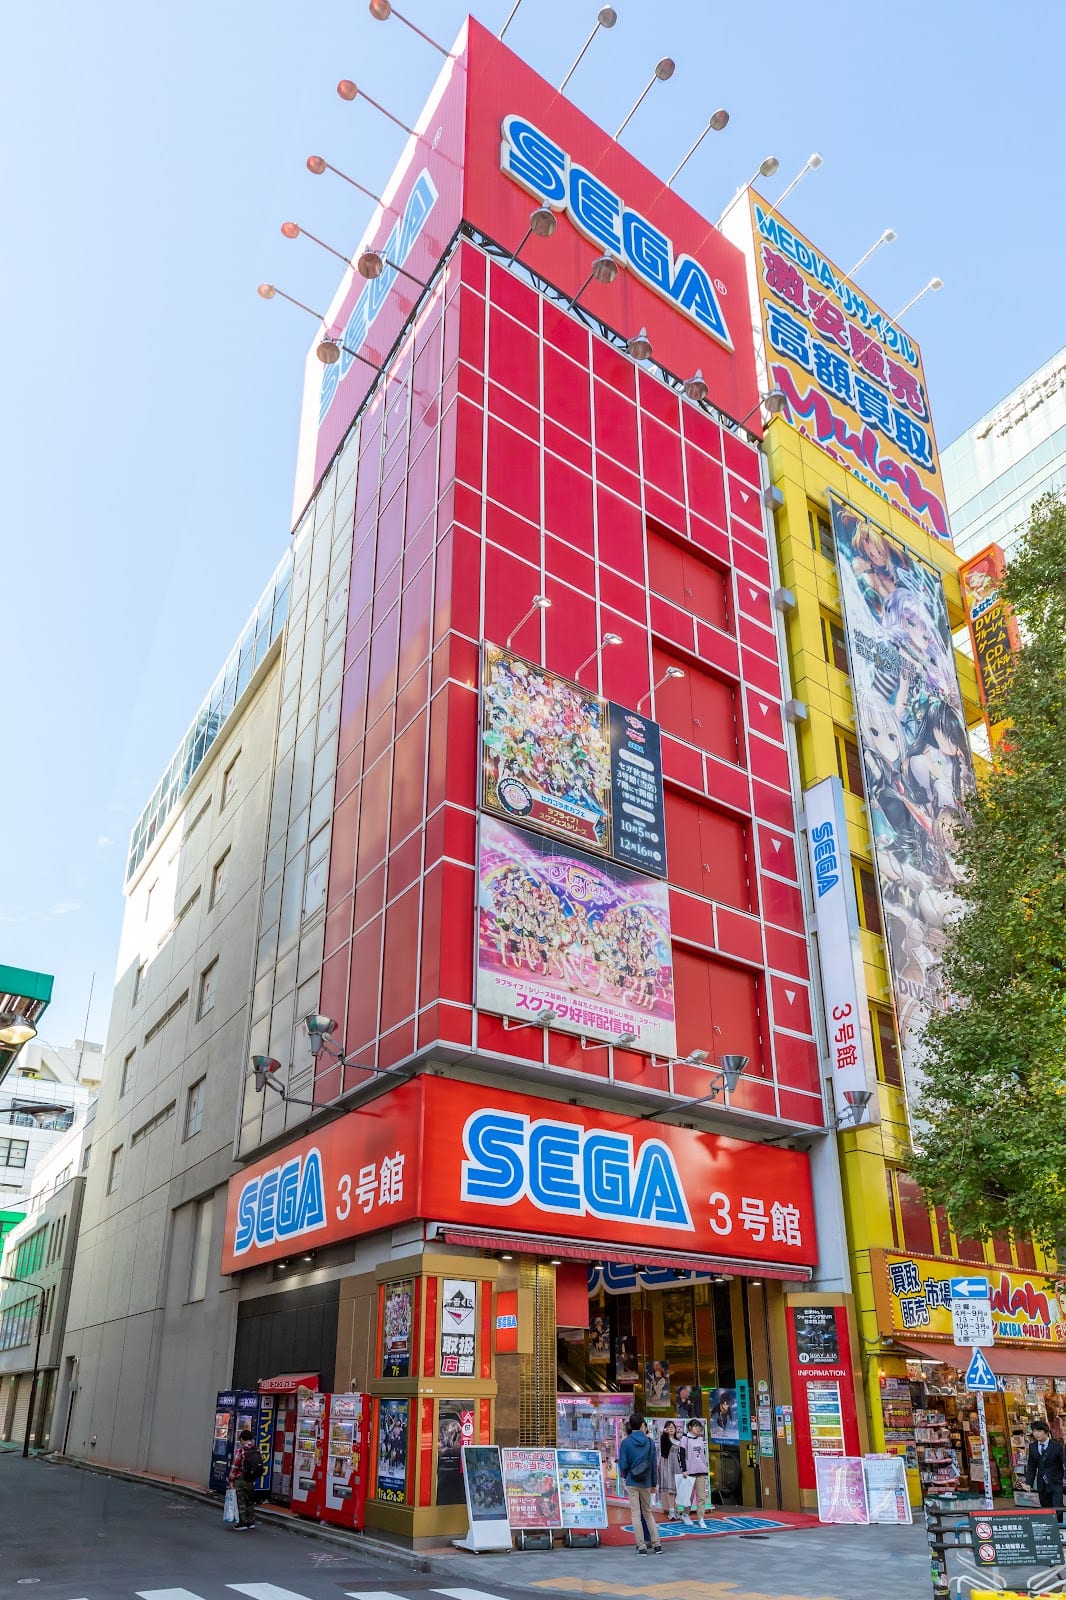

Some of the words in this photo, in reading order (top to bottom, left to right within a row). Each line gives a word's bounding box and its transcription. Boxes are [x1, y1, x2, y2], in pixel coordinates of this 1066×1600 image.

[502, 115, 734, 351] SEGA
[318, 168, 438, 425] SEGA
[761, 244, 926, 418] 激安販売
[765, 299, 935, 472] 高額買取
[772, 365, 950, 538] Mulan
[975, 607, 1001, 631] DVD
[979, 631, 1007, 653] ゲーム
[986, 644, 1004, 662] CD
[541, 795, 586, 818] セガコラボカフェ
[811, 821, 840, 898] SEGA
[832, 1003, 858, 1070] 3号館
[461, 1108, 695, 1232] SEGA
[709, 1191, 802, 1247] 3号館
[233, 1147, 327, 1257] SEGA
[336, 1151, 405, 1221] 3号館
[889, 1261, 921, 1296] 買取
[924, 1277, 952, 1310] 市場
[445, 1297, 473, 1308] 一番くじ
[901, 1295, 930, 1329] 販売
[497, 1315, 518, 1329] SEGA
[442, 1335, 474, 1355] 取扱
[391, 1365, 400, 1377] 7F
[442, 1355, 474, 1373] 店舗
[797, 1369, 846, 1377] INFORMATION
[258, 1409, 273, 1489] コインロッカー
